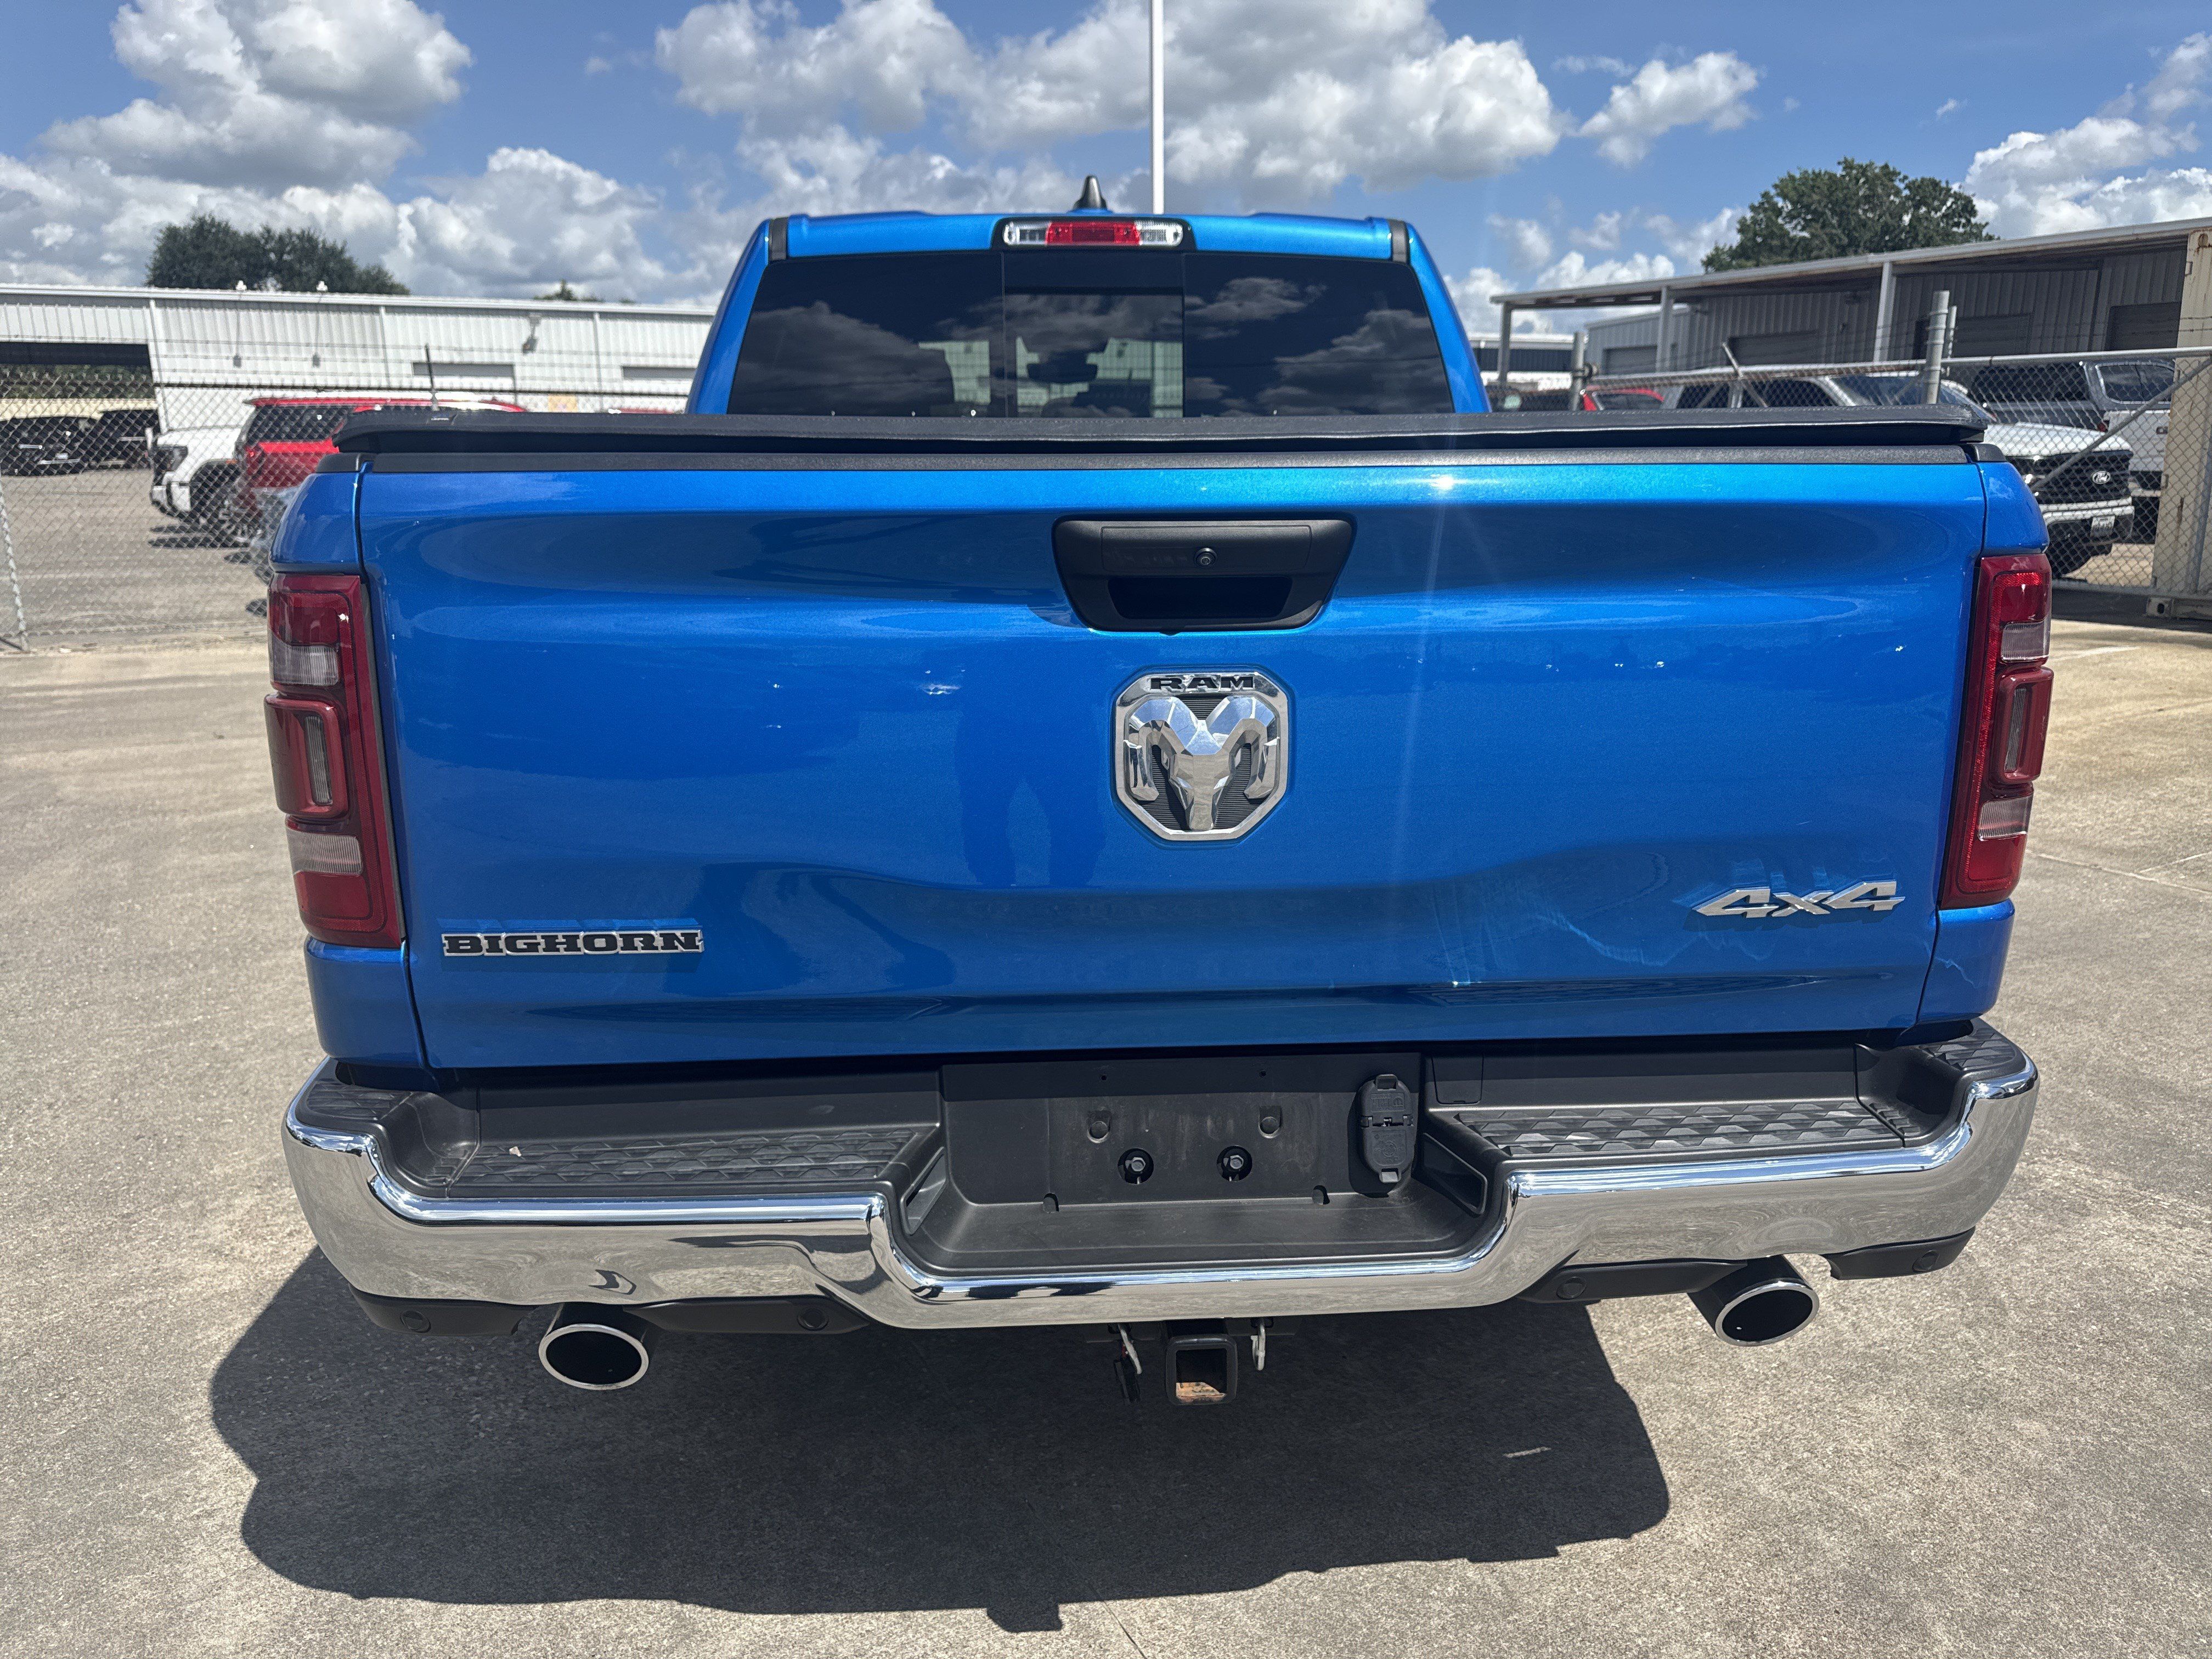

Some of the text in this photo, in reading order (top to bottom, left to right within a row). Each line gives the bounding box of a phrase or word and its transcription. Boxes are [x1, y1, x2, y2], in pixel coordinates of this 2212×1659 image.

[1150, 676, 1254, 691] RAM
[1692, 879, 1906, 919] 4x4
[441, 929, 705, 957] BIGHORN
